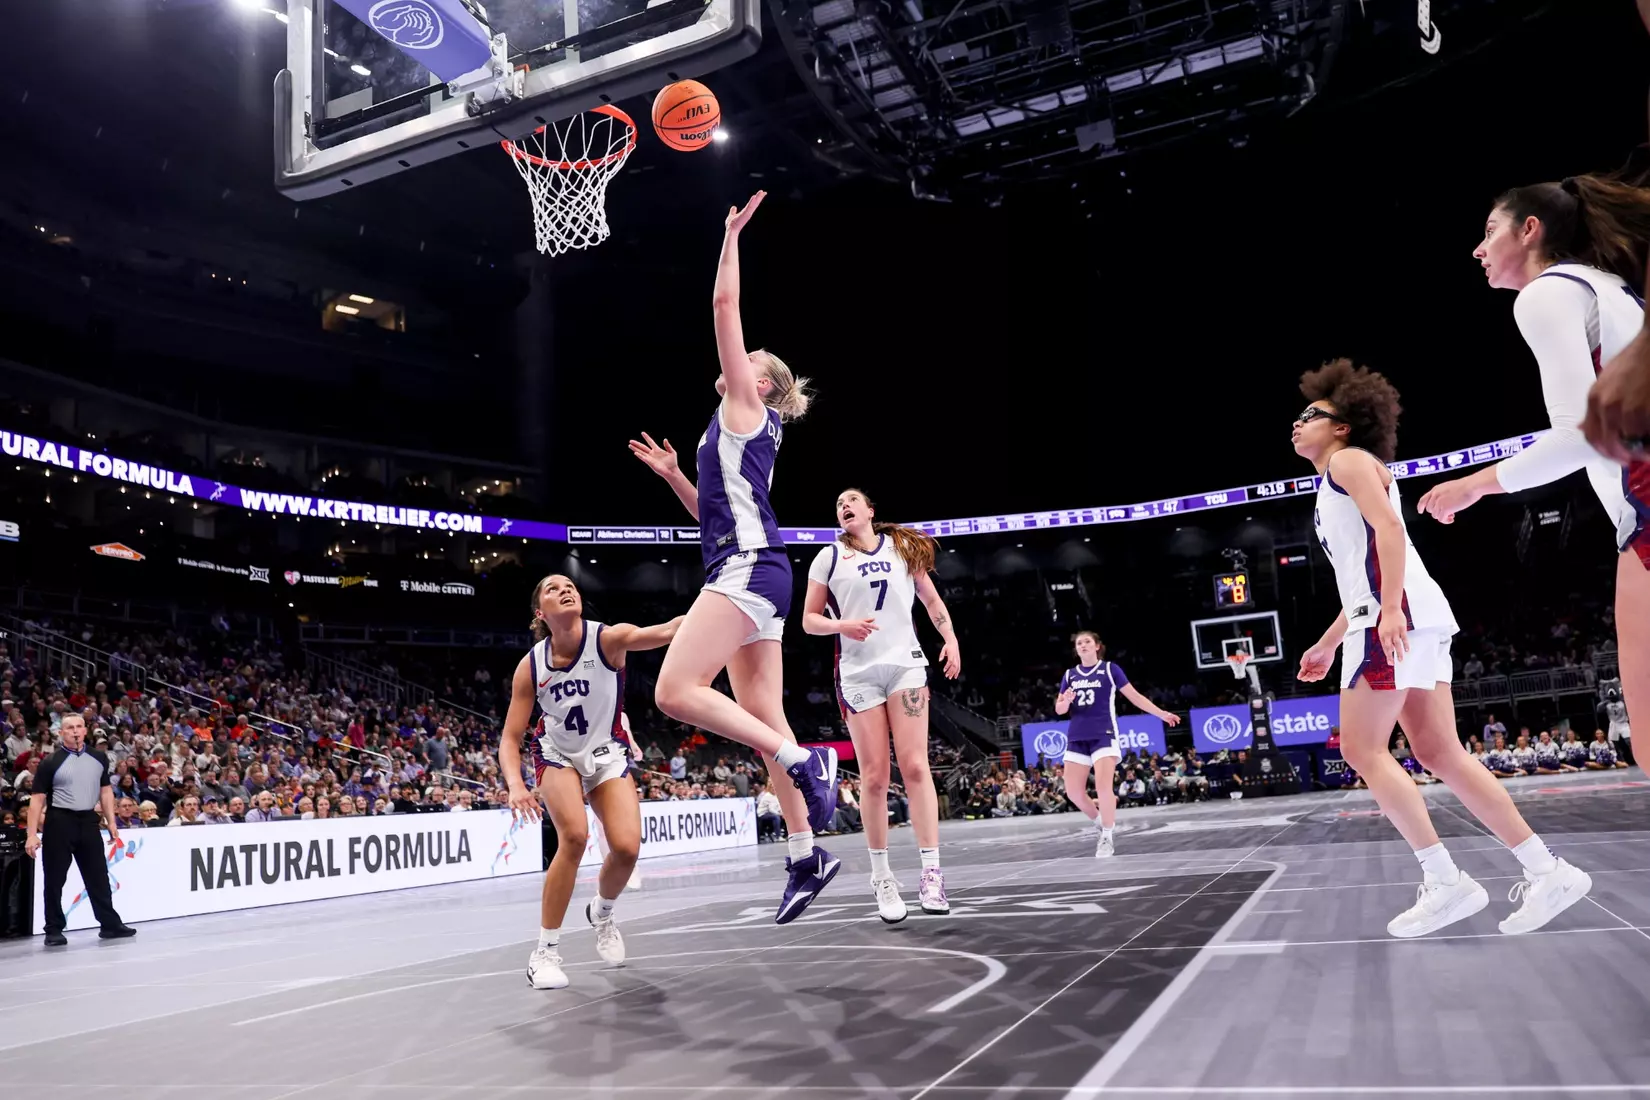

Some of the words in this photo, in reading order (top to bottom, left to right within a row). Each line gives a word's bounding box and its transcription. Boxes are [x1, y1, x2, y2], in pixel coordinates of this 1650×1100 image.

[0, 431, 73, 469] URAL
[79, 450, 194, 496] FORMULA
[1163, 500, 1178, 512] 47
[1204, 493, 1228, 505] TCU
[240, 488, 482, 534] WWW.KRTRELIEF.COM
[623, 530, 655, 539] Christian
[857, 560, 892, 577] TCU
[302, 574, 325, 584] TASTES
[410, 581, 440, 593] Mobile
[441, 585, 472, 595] CENTER
[870, 579, 888, 611] 7
[1233, 585, 1245, 603] 8
[550, 679, 590, 703] TCU
[1071, 679, 1102, 690] Wildcats
[1076, 689, 1095, 706] 23
[564, 705, 589, 736] 4
[640, 814, 675, 844] URAL
[678, 811, 737, 840] FORMULA
[190, 838, 341, 892] NATURAL
[349, 829, 472, 875] FORMULA
